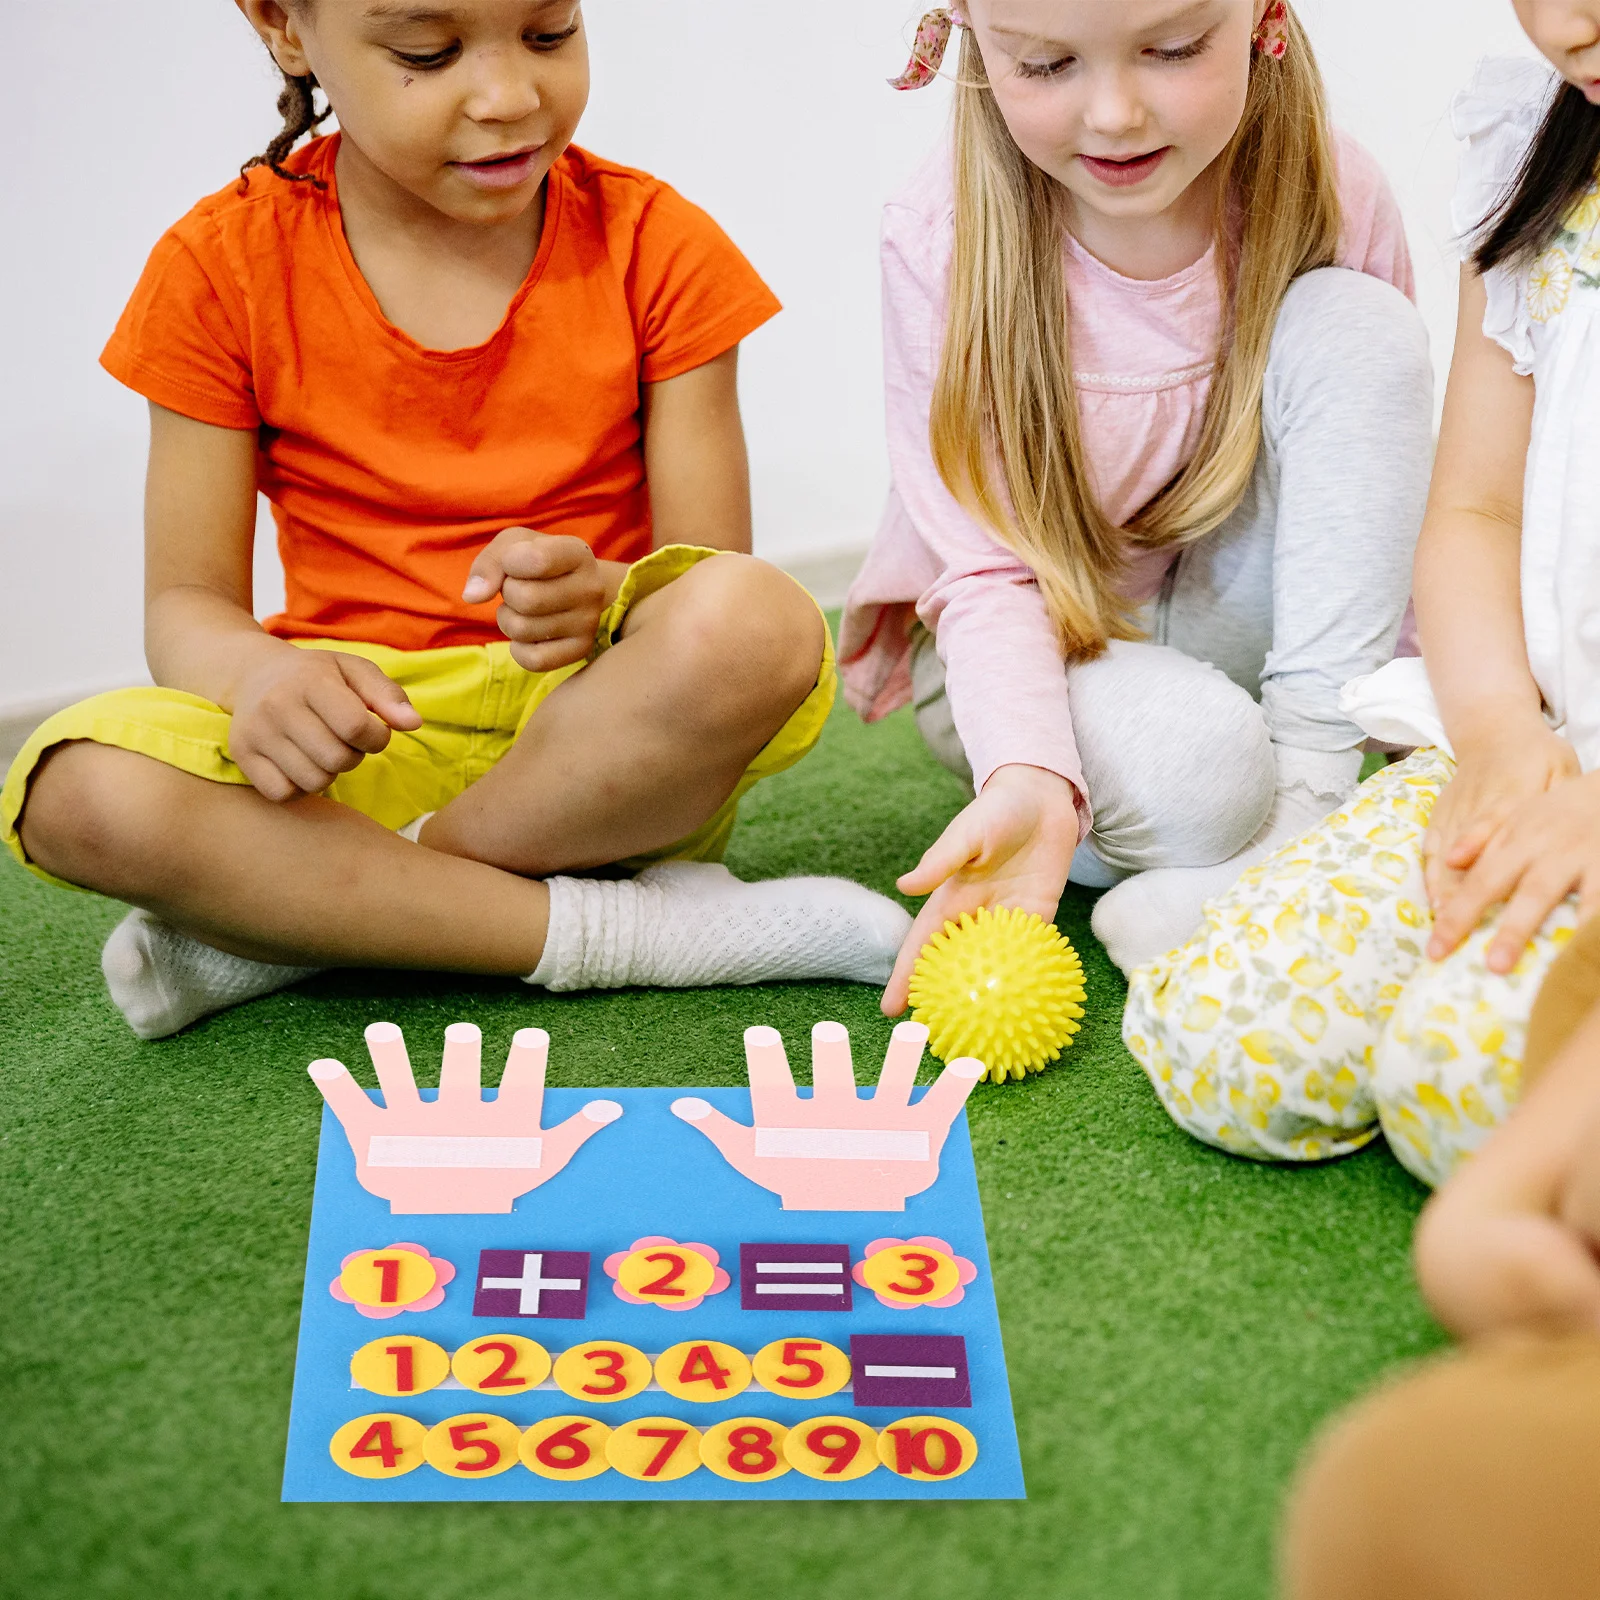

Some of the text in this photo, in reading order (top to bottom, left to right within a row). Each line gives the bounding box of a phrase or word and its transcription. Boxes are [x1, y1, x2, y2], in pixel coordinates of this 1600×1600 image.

[372, 1258, 399, 1303] 1
[639, 1253, 687, 1297] 2
[888, 1253, 939, 1296] 3
[386, 1346, 415, 1392] 1
[472, 1342, 526, 1389] 2
[581, 1350, 628, 1396] 3
[678, 1345, 731, 1390] 4
[775, 1342, 825, 1388] 5
[349, 1421, 963, 1477] 4 5 6 7 8 9 10
